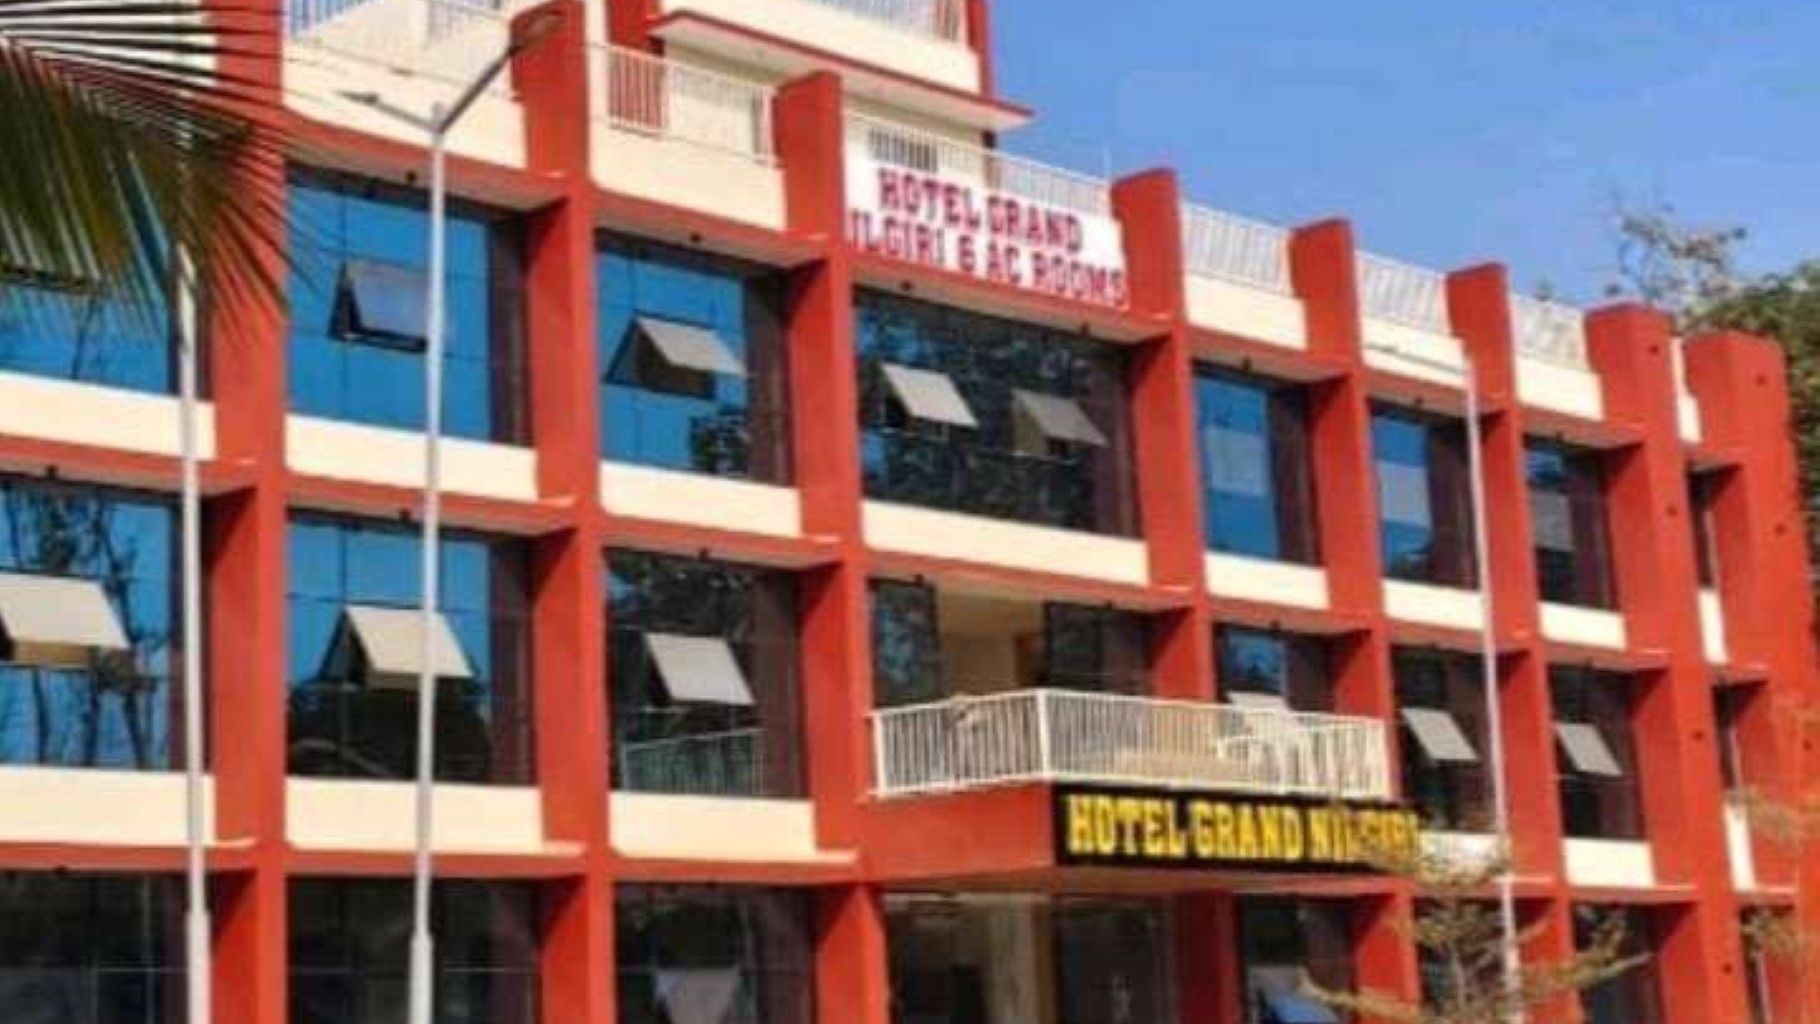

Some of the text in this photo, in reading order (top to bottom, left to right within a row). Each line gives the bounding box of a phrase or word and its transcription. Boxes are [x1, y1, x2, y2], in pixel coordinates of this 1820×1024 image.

[879, 169, 1082, 253] HOTEL GRAND
[846, 207, 945, 265] ILGIRI
[987, 239, 1022, 286] AC
[1030, 250, 1129, 306] ROOMS
[1068, 794, 1186, 857] HOTEL
[1192, 800, 1303, 860] GRAND
